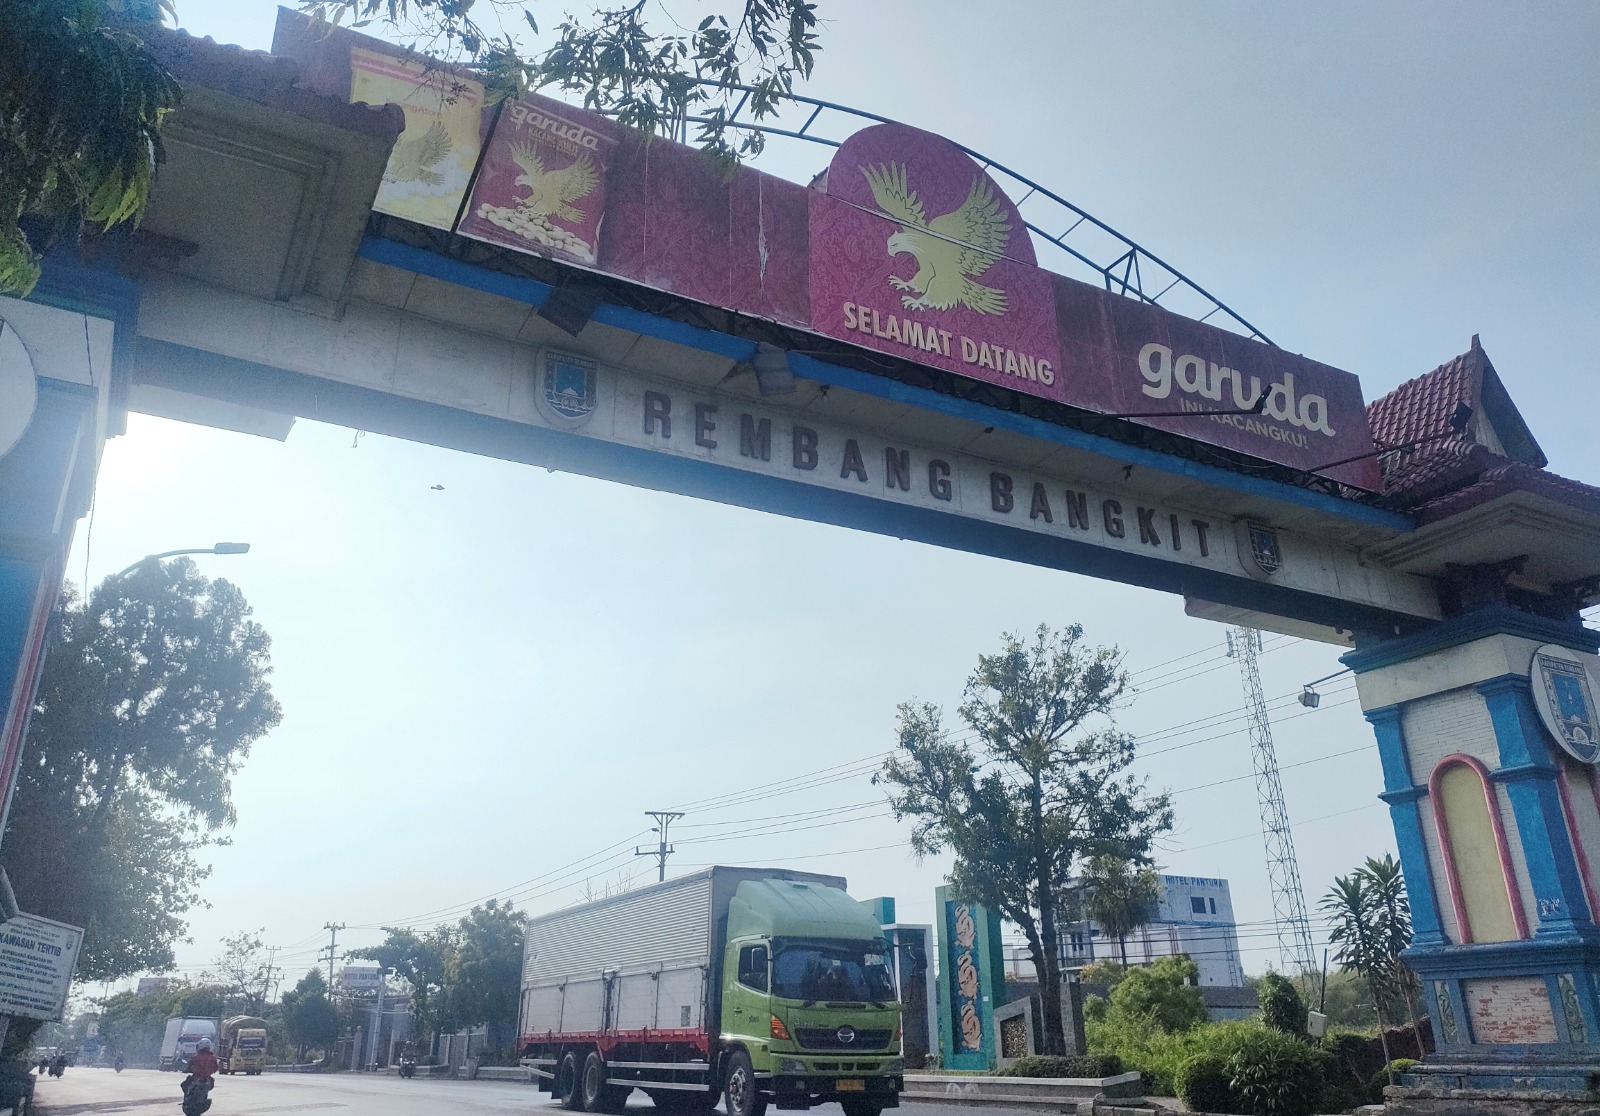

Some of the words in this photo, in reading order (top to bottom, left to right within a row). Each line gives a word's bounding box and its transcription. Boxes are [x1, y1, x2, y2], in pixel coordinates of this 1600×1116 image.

[510, 105, 599, 151] garuda
[843, 301, 953, 358] SELAMAT
[960, 335, 1055, 386] DATANG
[1138, 342, 1336, 437] garuda
[643, 389, 953, 502] REMBANG
[990, 471, 1210, 557] BANGKIT
[1165, 875, 1190, 886] HOTEL
[1191, 877, 1223, 888] PANTURA
[0, 932, 36, 951] KAWASAN
[37, 942, 62, 957] TERTIB
